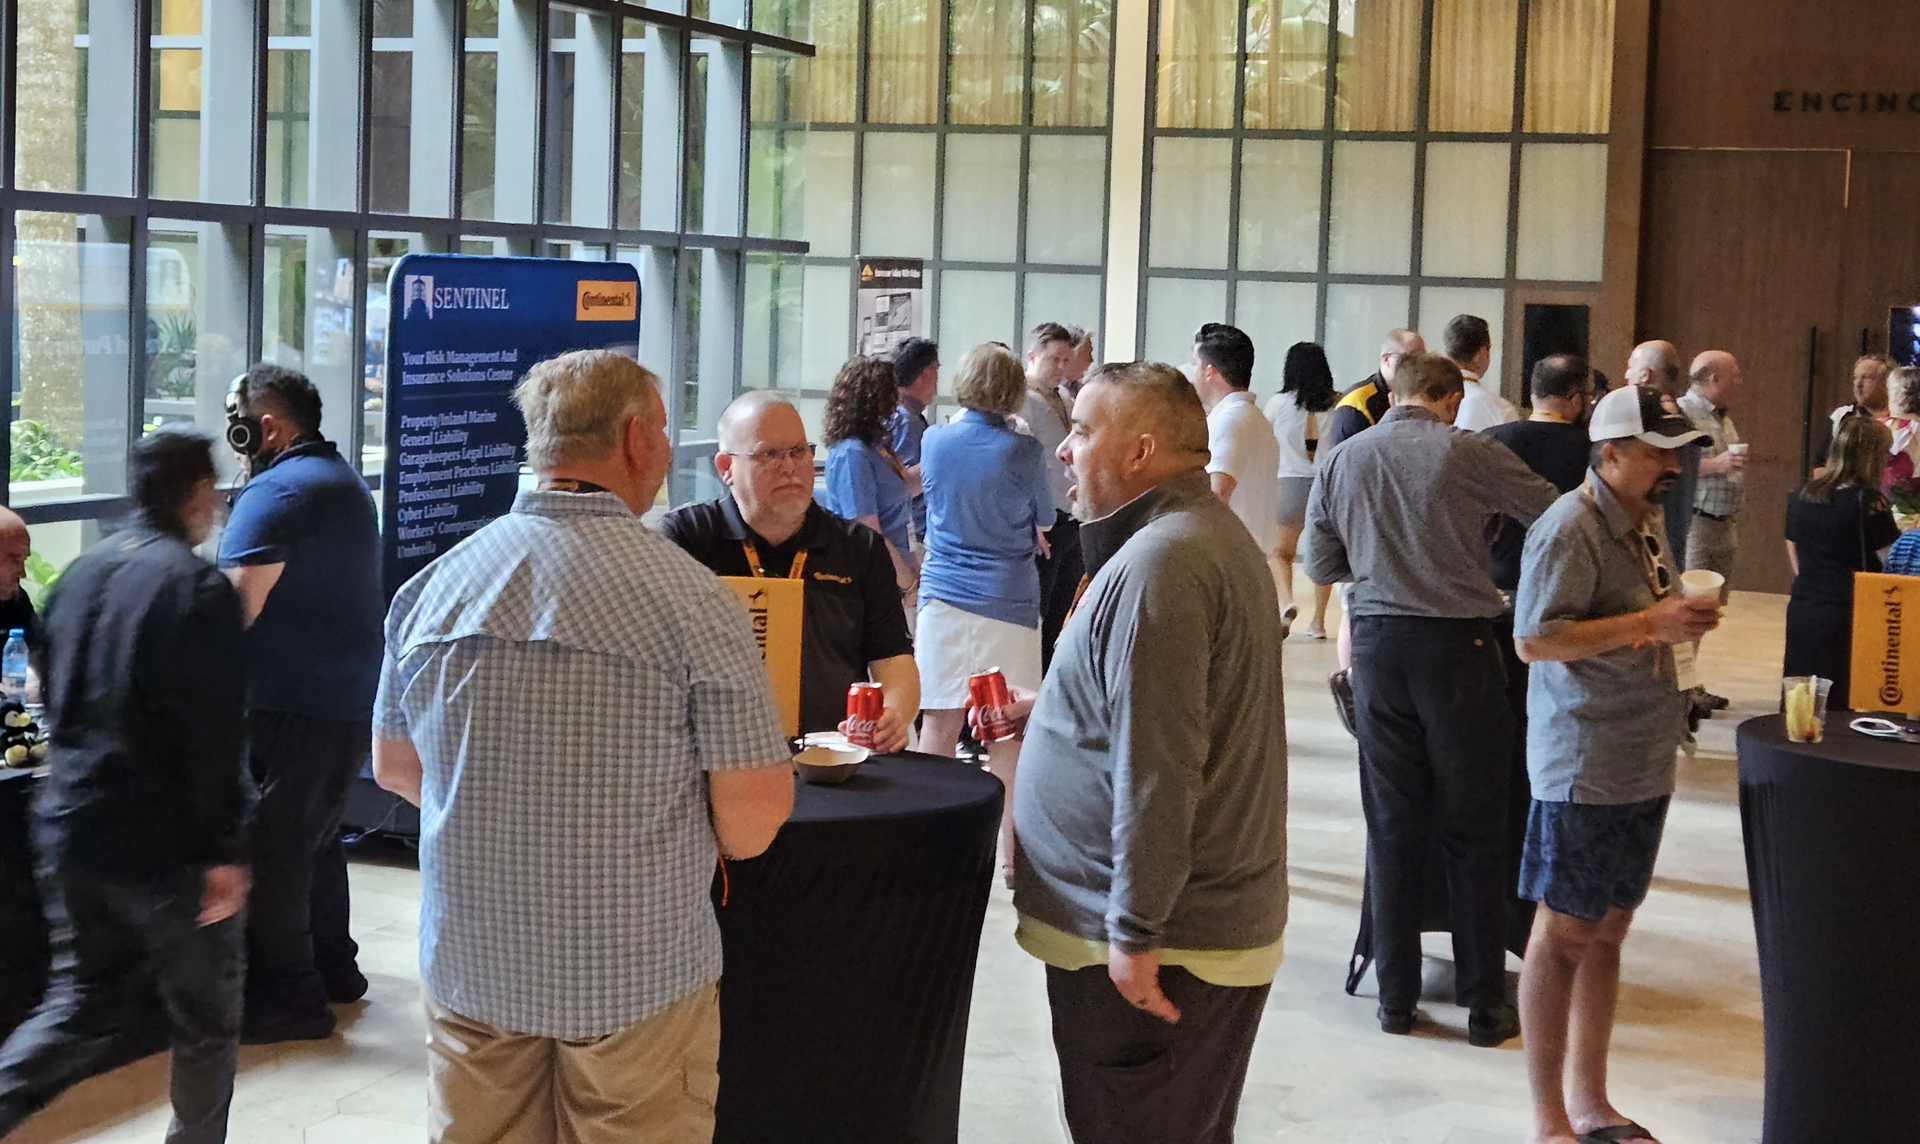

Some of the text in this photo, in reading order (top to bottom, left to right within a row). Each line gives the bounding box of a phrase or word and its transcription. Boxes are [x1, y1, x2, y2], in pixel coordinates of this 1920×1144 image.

[433, 287, 510, 310] SENTINEL
[402, 348, 518, 367] Your Risk Management And
[402, 371, 446, 386] Insurance
[446, 368, 486, 383] Solutions
[486, 367, 513, 382] Center
[468, 410, 497, 424] Marine
[400, 428, 469, 447] General Liability
[399, 443, 517, 468] Garagekeepers Legal Liability
[398, 468, 453, 487] Employment
[454, 463, 490, 479] Practices
[398, 481, 485, 504] Professional Liability
[397, 503, 459, 525] Cyber Liability
[1879, 601, 1904, 706] Continental
